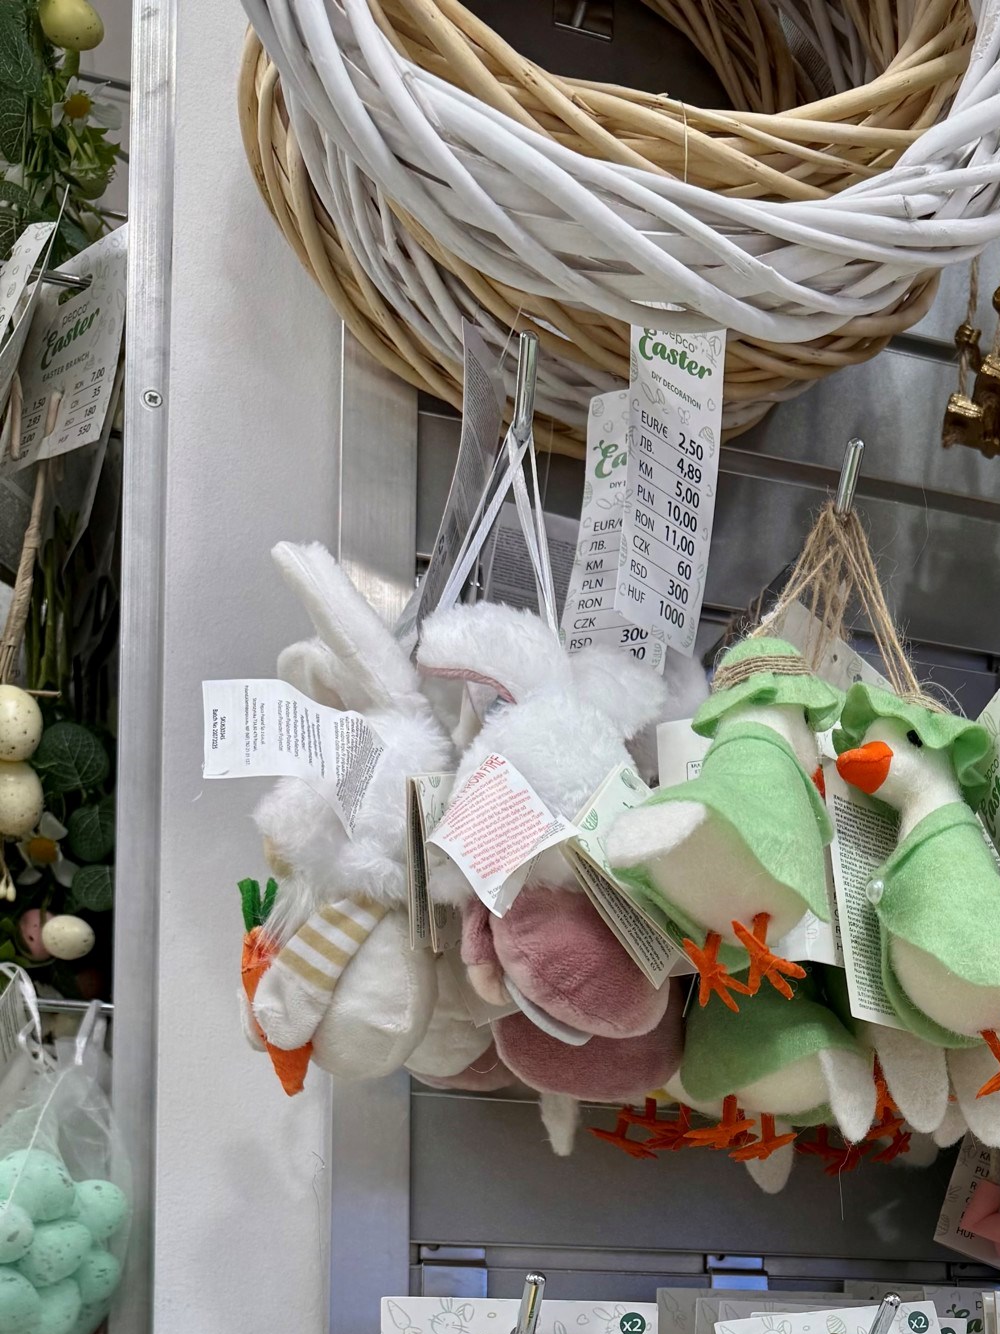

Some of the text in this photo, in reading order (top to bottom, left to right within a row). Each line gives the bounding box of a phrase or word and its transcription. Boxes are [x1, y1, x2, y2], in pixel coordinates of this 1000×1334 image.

[41, 307, 100, 370] Easter
[638, 328, 712, 379] Easter
[42, 351, 90, 382] EASTER BRANCH
[651, 371, 701, 410] DIY DECORATION
[641, 410, 703, 461] EUR/€ 2,50
[638, 459, 699, 508] KM 5,00
[676, 458, 701, 484] 4,89
[637, 484, 697, 533] PLN 10,00
[635, 509, 695, 557] RON 11,00
[586, 560, 603, 571] KM
[633, 535, 692, 581] CZK 60
[630, 559, 689, 605] RSD 300
[627, 584, 684, 629] HUF 1000
[622, 1319, 642, 1332] x2
[910, 1316, 927, 1329] x2
